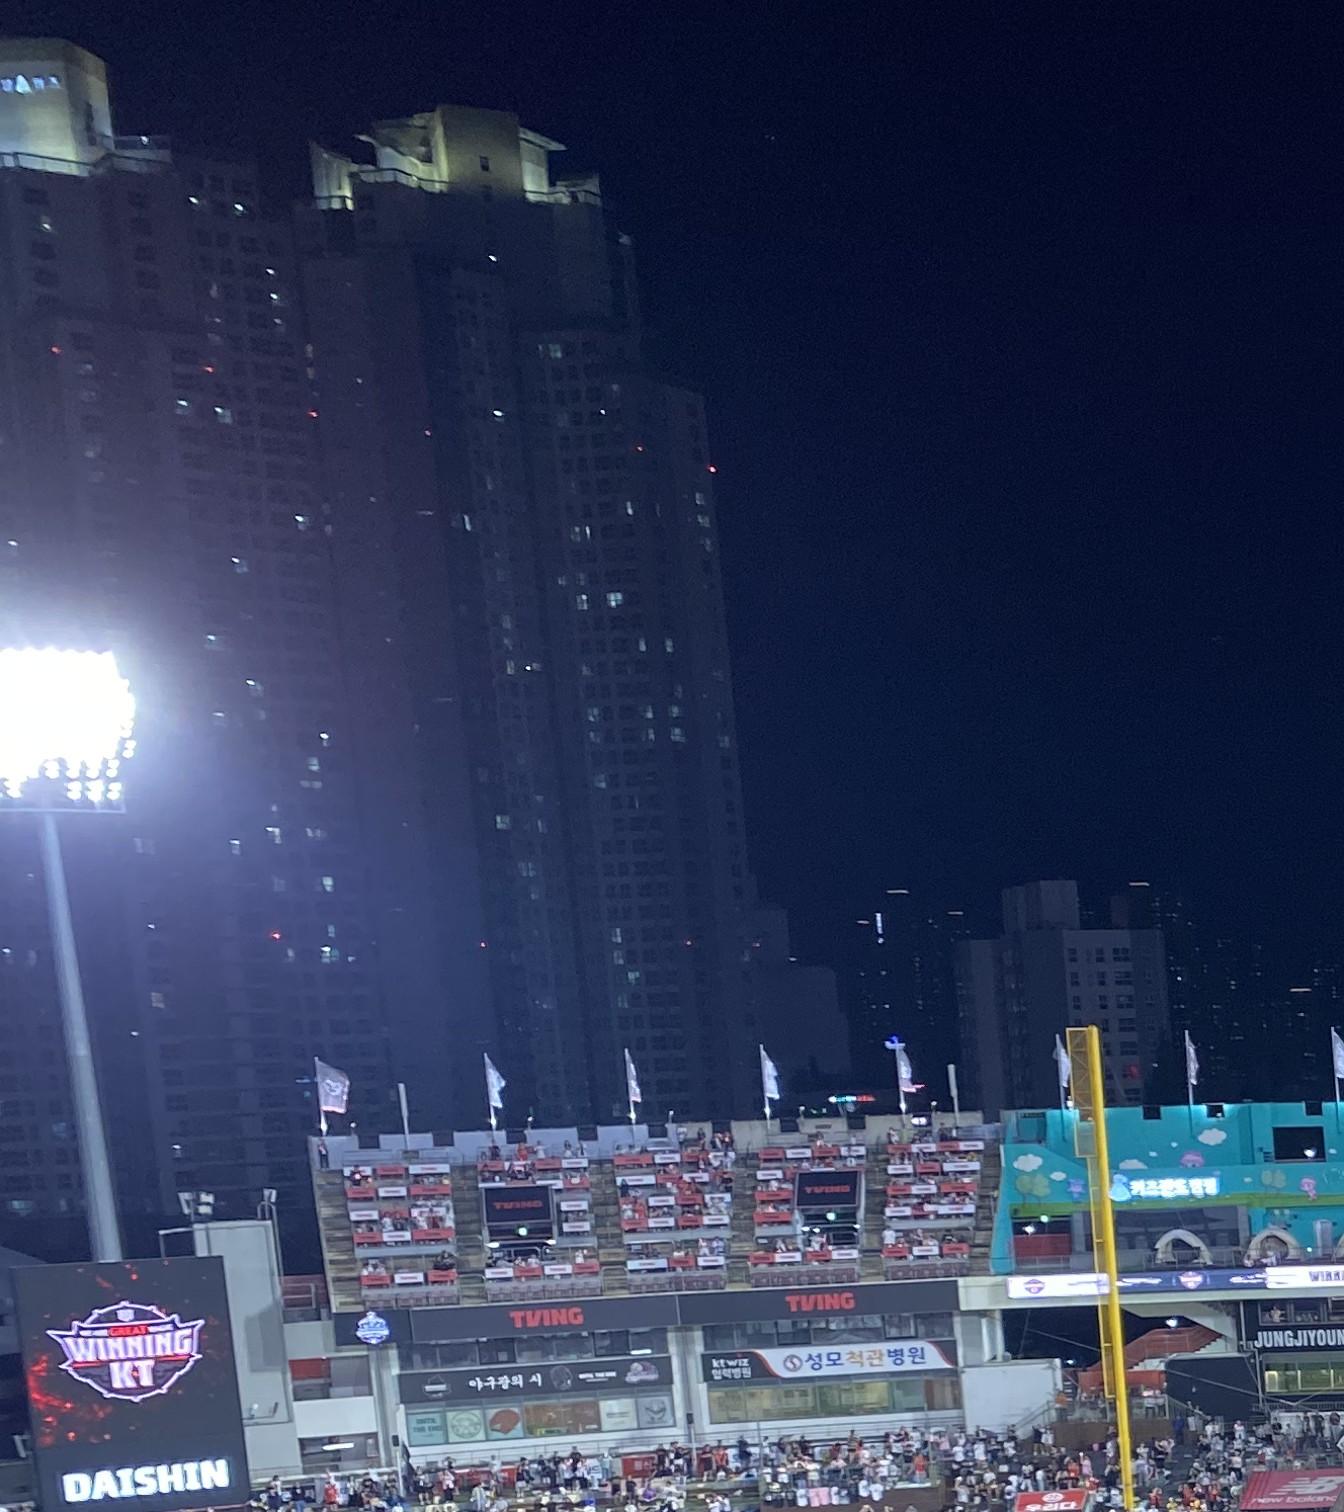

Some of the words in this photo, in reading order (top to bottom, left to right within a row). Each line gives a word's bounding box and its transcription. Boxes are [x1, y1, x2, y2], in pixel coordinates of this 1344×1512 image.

[785, 1292, 856, 1312] TVING
[510, 1307, 584, 1328] TVING
[110, 1325, 148, 1336] GREAT
[64, 1330, 192, 1362] WINNING
[109, 1360, 155, 1389] KT
[62, 1458, 230, 1503] DAISHIN
